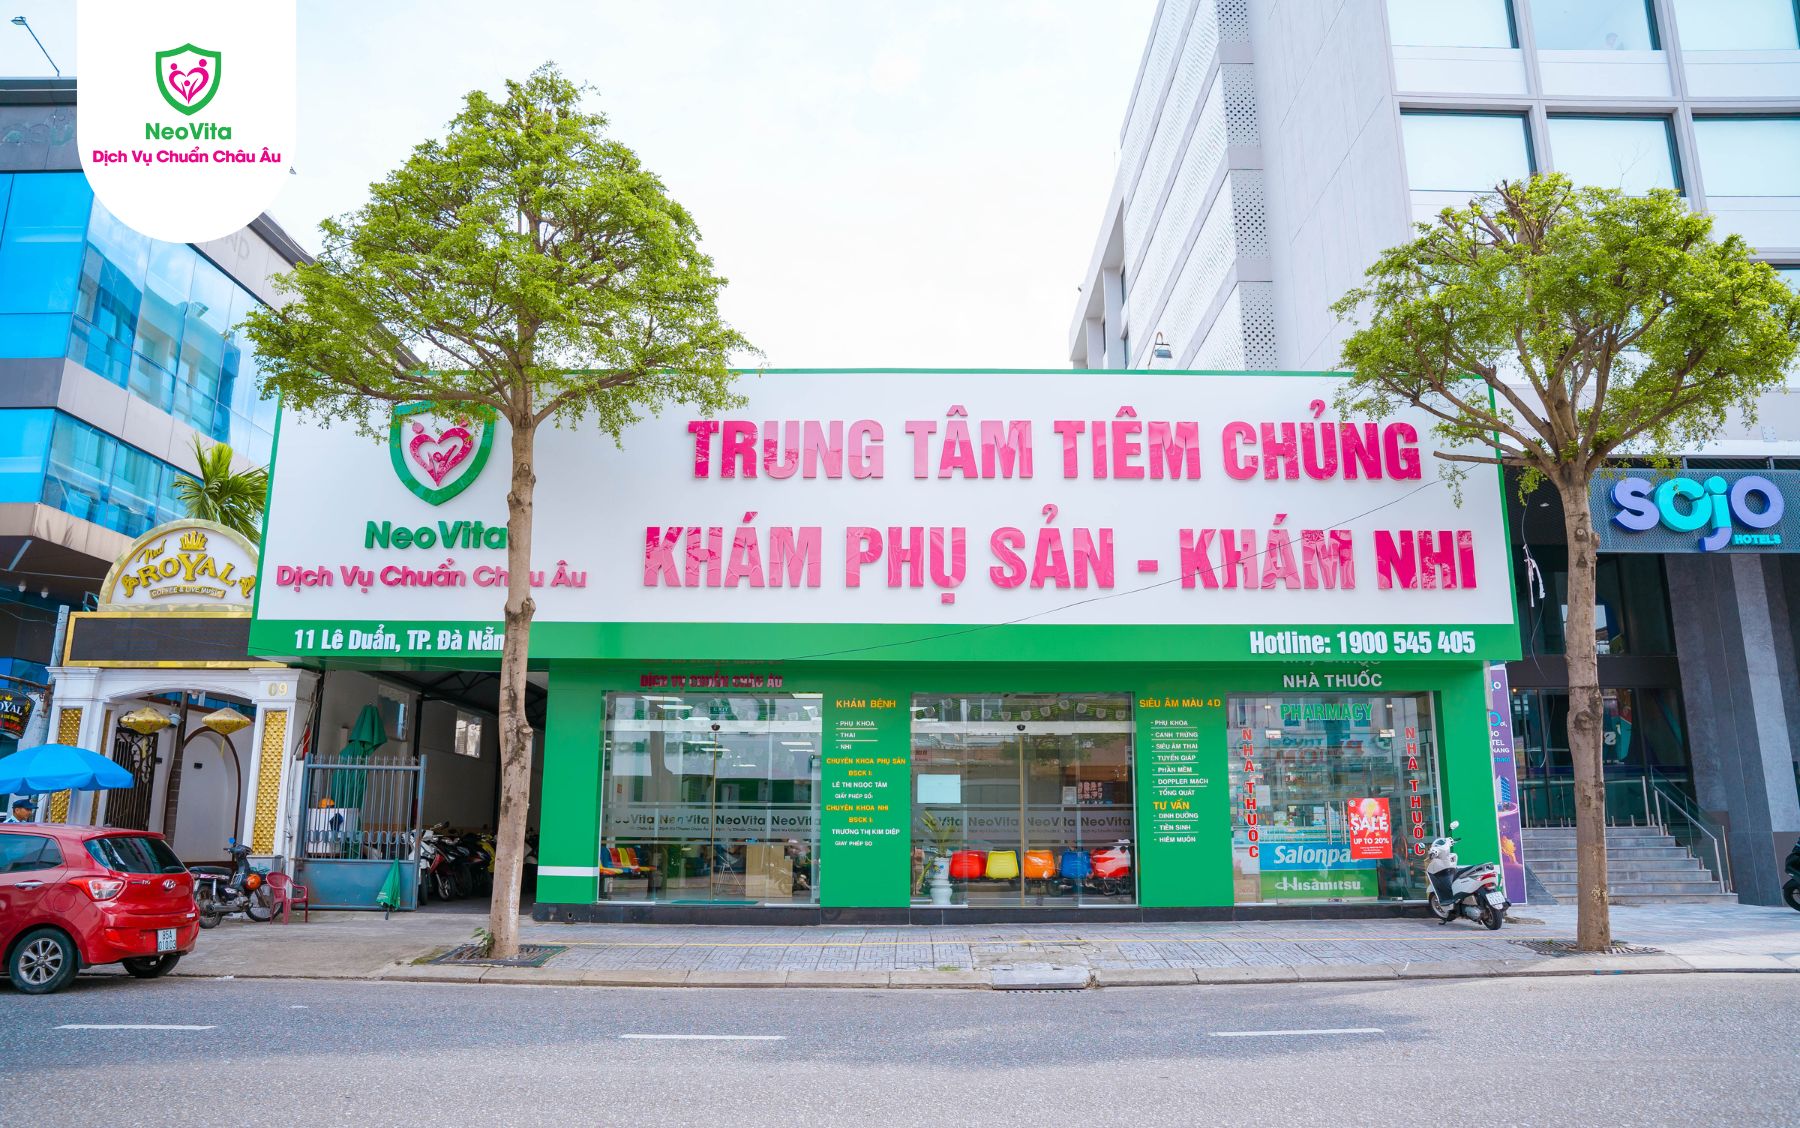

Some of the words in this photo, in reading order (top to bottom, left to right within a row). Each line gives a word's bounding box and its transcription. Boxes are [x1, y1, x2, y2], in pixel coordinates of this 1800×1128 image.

[688, 420, 884, 479] TRUNG
[905, 405, 1033, 479] TÂM
[1054, 405, 1201, 480] TIÊM
[1221, 399, 1422, 480] CHỦNG
[364, 520, 508, 549] NeoVita
[1732, 534, 1782, 546] HOTELS
[643, 511, 822, 588] KHÁM
[845, 526, 967, 604] PHỤ
[989, 504, 1114, 589] SẢN
[1179, 513, 1356, 589] KHÁM
[1374, 530, 1477, 589] NHI
[137, 553, 237, 588] ROYAL
[276, 565, 333, 592] Dịch
[340, 566, 374, 593] Vụ
[379, 557, 466, 588] Chuẩn
[472, 565, 544, 588] Chu
[551, 560, 587, 588] Âu
[294, 629, 315, 650] 11
[322, 628, 343, 650] Lê
[348, 624, 401, 653] Duẩn,
[407, 629, 431, 650] TP.
[437, 628, 462, 650] Đà
[467, 626, 504, 651] Nẵn
[1250, 631, 1330, 655] Hotline:
[1337, 631, 1388, 654] 1900
[1393, 631, 1432, 654] 545
[1437, 631, 1476, 654] 405
[640, 672, 668, 689] DỊCH
[671, 674, 687, 690] VỤ
[732, 672, 764, 688] CHÂU
[767, 672, 784, 688] ÂU
[1283, 671, 1320, 688] NHÀ
[1324, 669, 1382, 688] THUỐC
[0, 700, 23, 716] OYAL
[836, 697, 866, 708] KHÁM
[870, 697, 896, 710] BỆNH
[1139, 697, 1161, 708] SIÊU
[1164, 697, 1179, 708] ÂM
[1280, 703, 1373, 720] PHARMACY
[856, 803, 875, 811] KHOA
[878, 803, 889, 811] NHI
[1170, 798, 1190, 810] VẤN
[716, 815, 766, 826] NeoVita
[968, 816, 1019, 827] NeoVita
[1027, 817, 1076, 827] NeoVta
[1081, 816, 1131, 827] NeoVita
[1351, 814, 1389, 833] SALE
